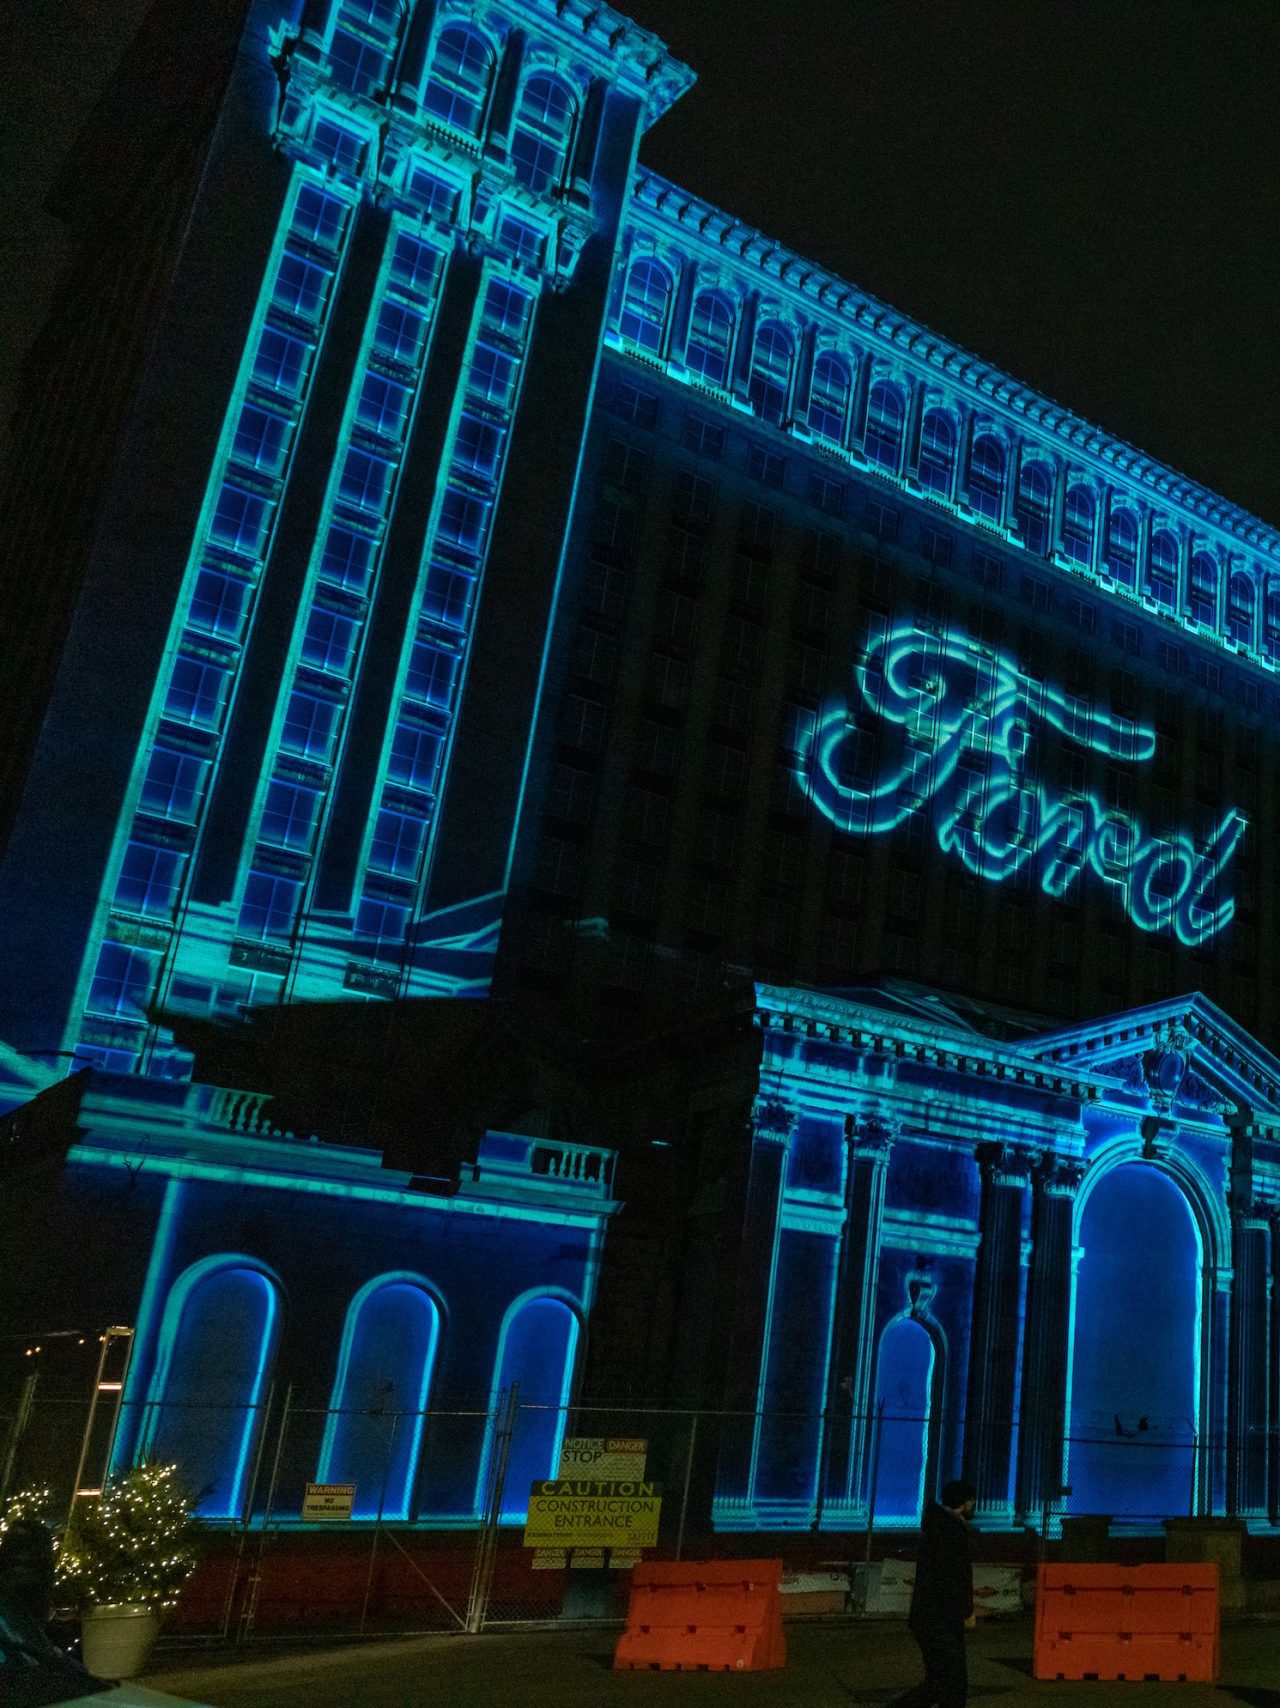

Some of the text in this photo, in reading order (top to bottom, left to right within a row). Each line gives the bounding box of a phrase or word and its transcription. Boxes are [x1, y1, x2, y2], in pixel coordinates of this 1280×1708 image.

[792, 624, 1250, 948] Ford
[607, 1440, 647, 1451] DANGER
[562, 1451, 603, 1463] STOP
[309, 1485, 354, 1495] WARNING
[540, 1481, 657, 1496] CAUTION
[535, 1499, 655, 1513] CONSTRUCTION
[554, 1514, 633, 1528] ENTRANCE
